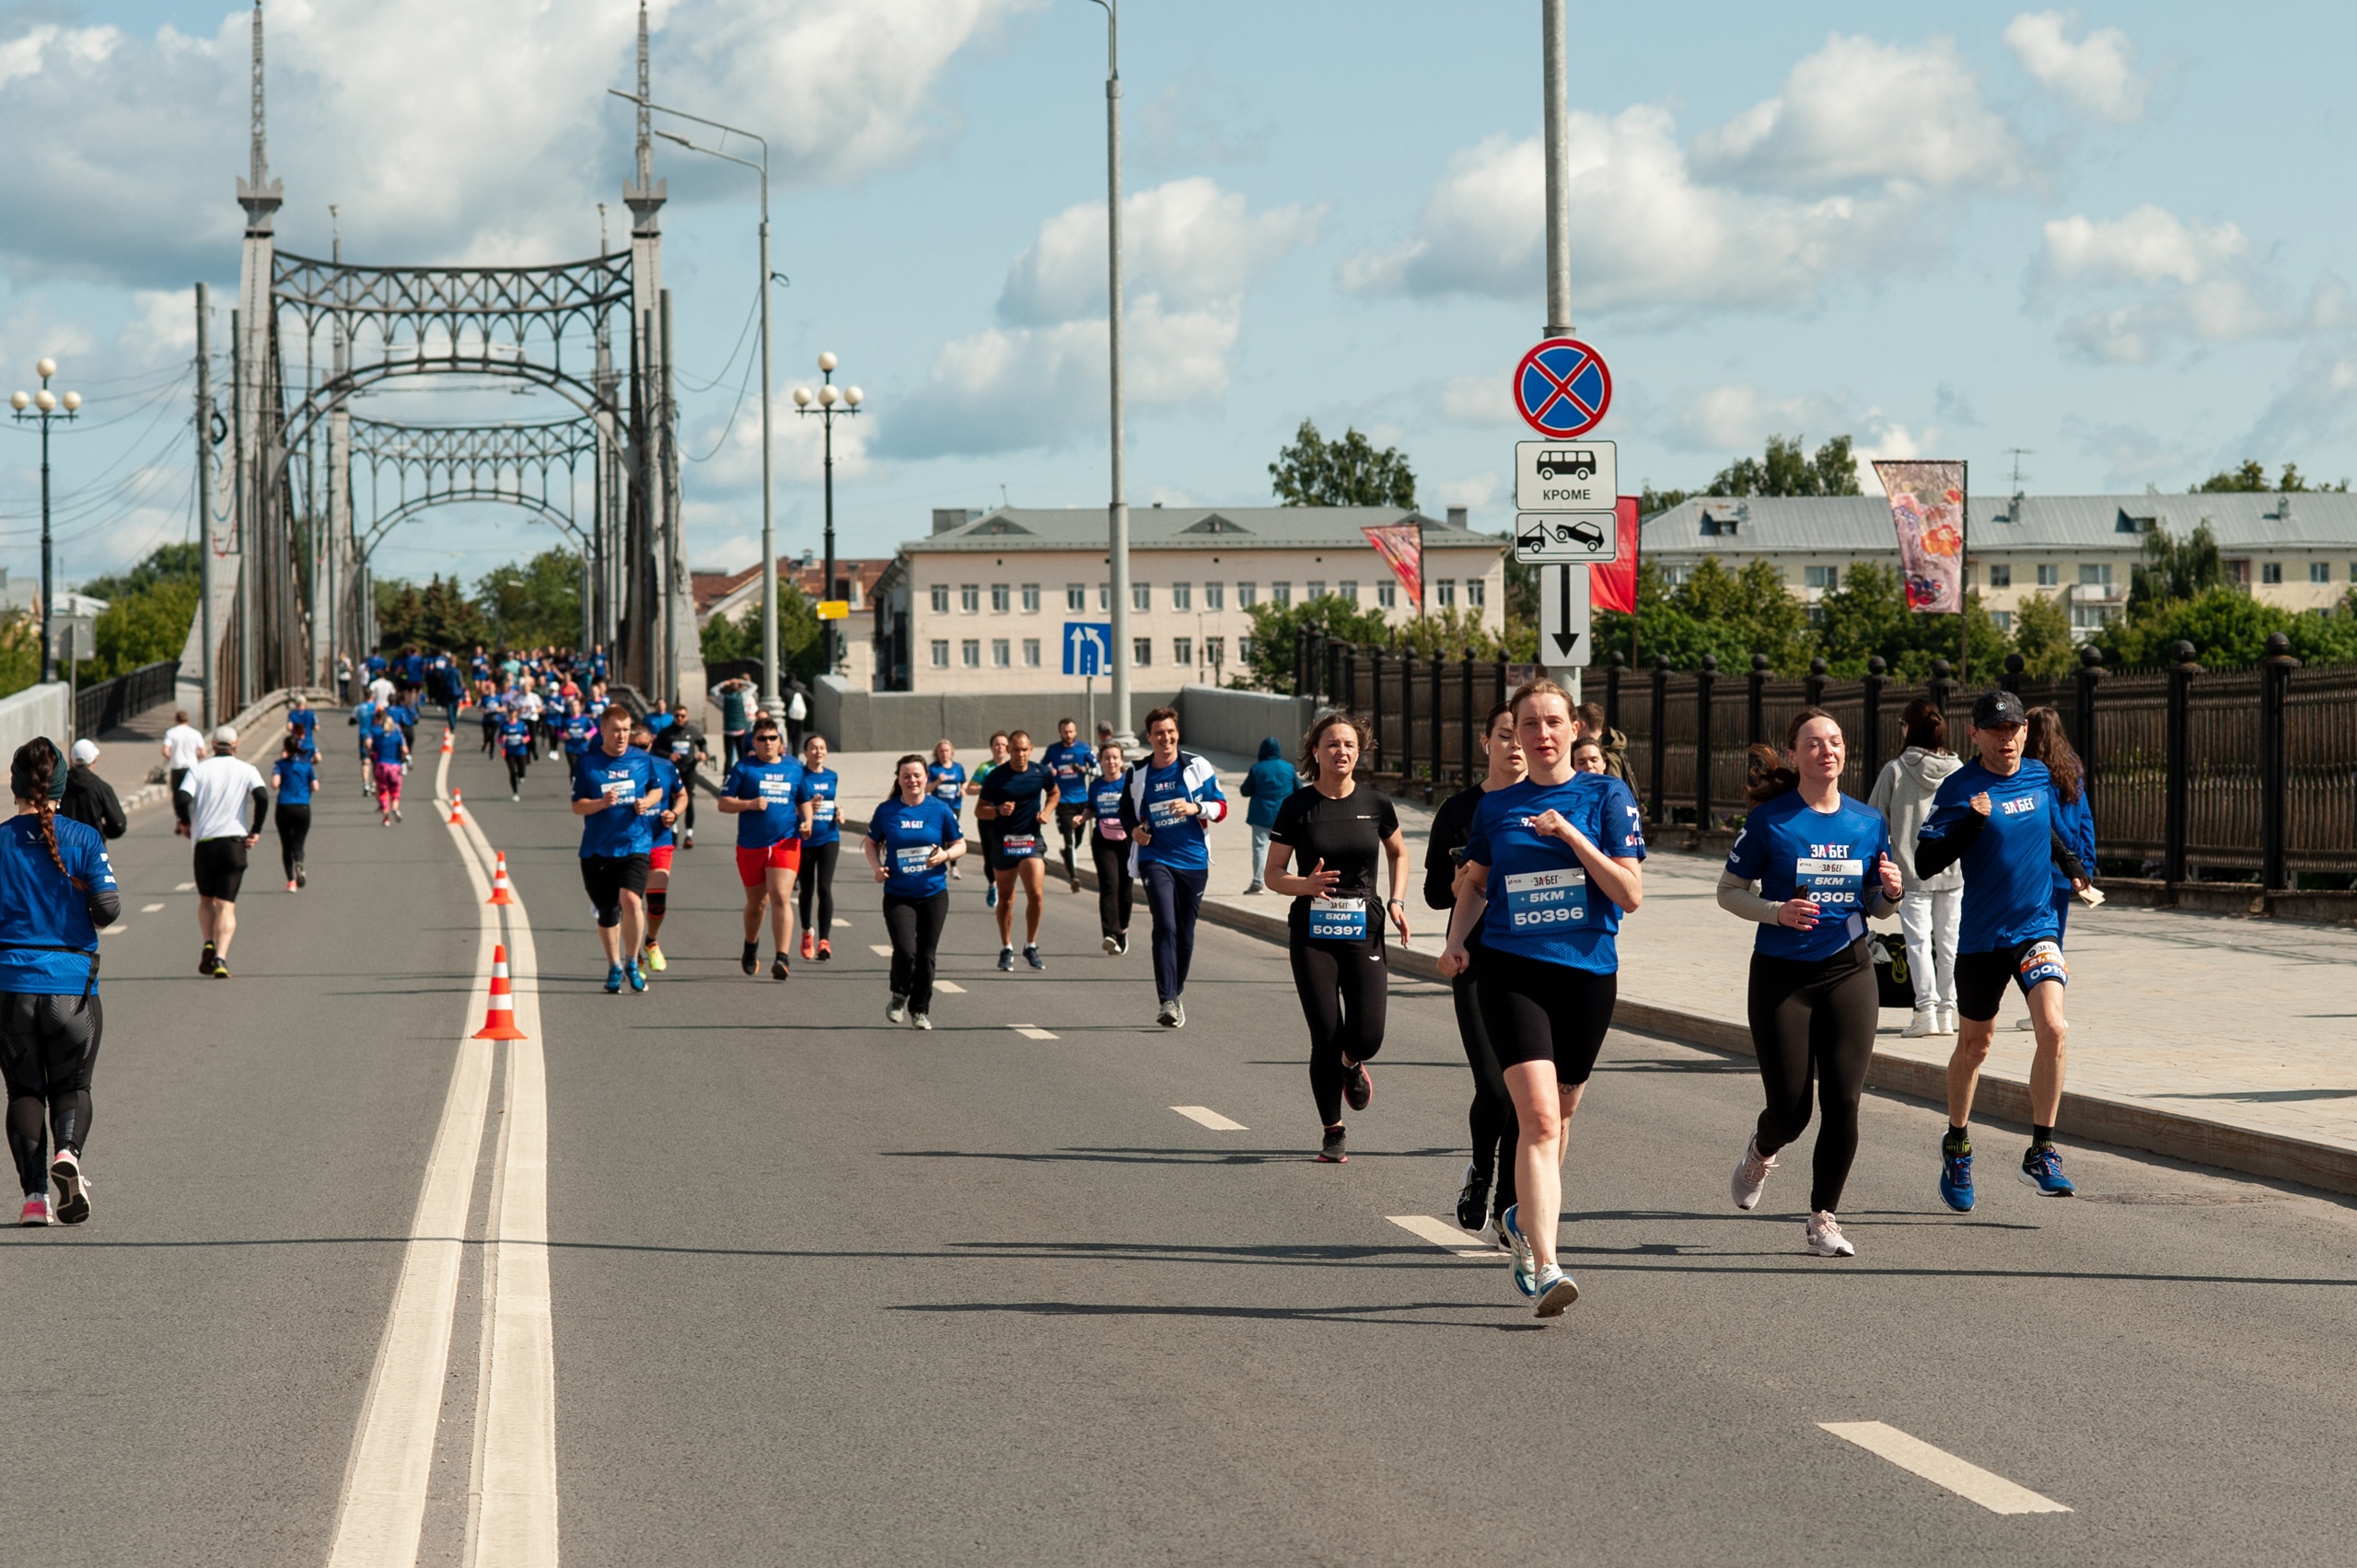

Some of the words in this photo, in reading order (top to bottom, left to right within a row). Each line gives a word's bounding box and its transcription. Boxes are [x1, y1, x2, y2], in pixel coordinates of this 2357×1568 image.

[1543, 489, 1591, 500] КРОМЕ
[1625, 806, 1640, 831] 7
[1734, 828, 1747, 848] 7
[902, 864, 928, 874] 5031
[1806, 891, 1855, 903] 0305
[1514, 907, 1585, 926] 50396
[1312, 925, 1363, 935] 50397
